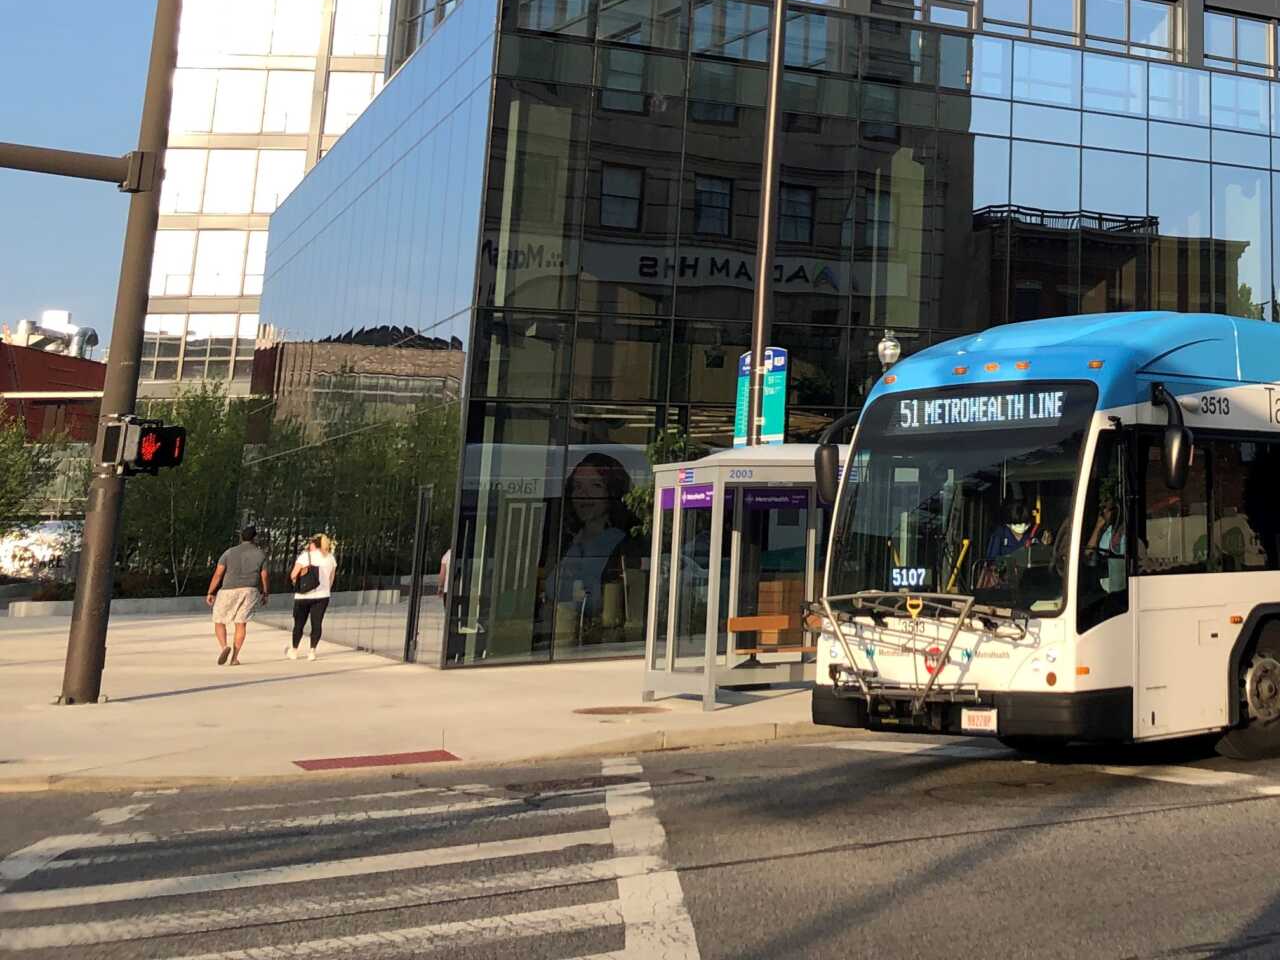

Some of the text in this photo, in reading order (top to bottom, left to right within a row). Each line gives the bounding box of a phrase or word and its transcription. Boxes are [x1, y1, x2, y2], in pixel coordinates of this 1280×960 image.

[900, 391, 1064, 428] 51 METROHEALTH LINE
[1200, 396, 1231, 416] 3513
[892, 568, 926, 586] 5107
